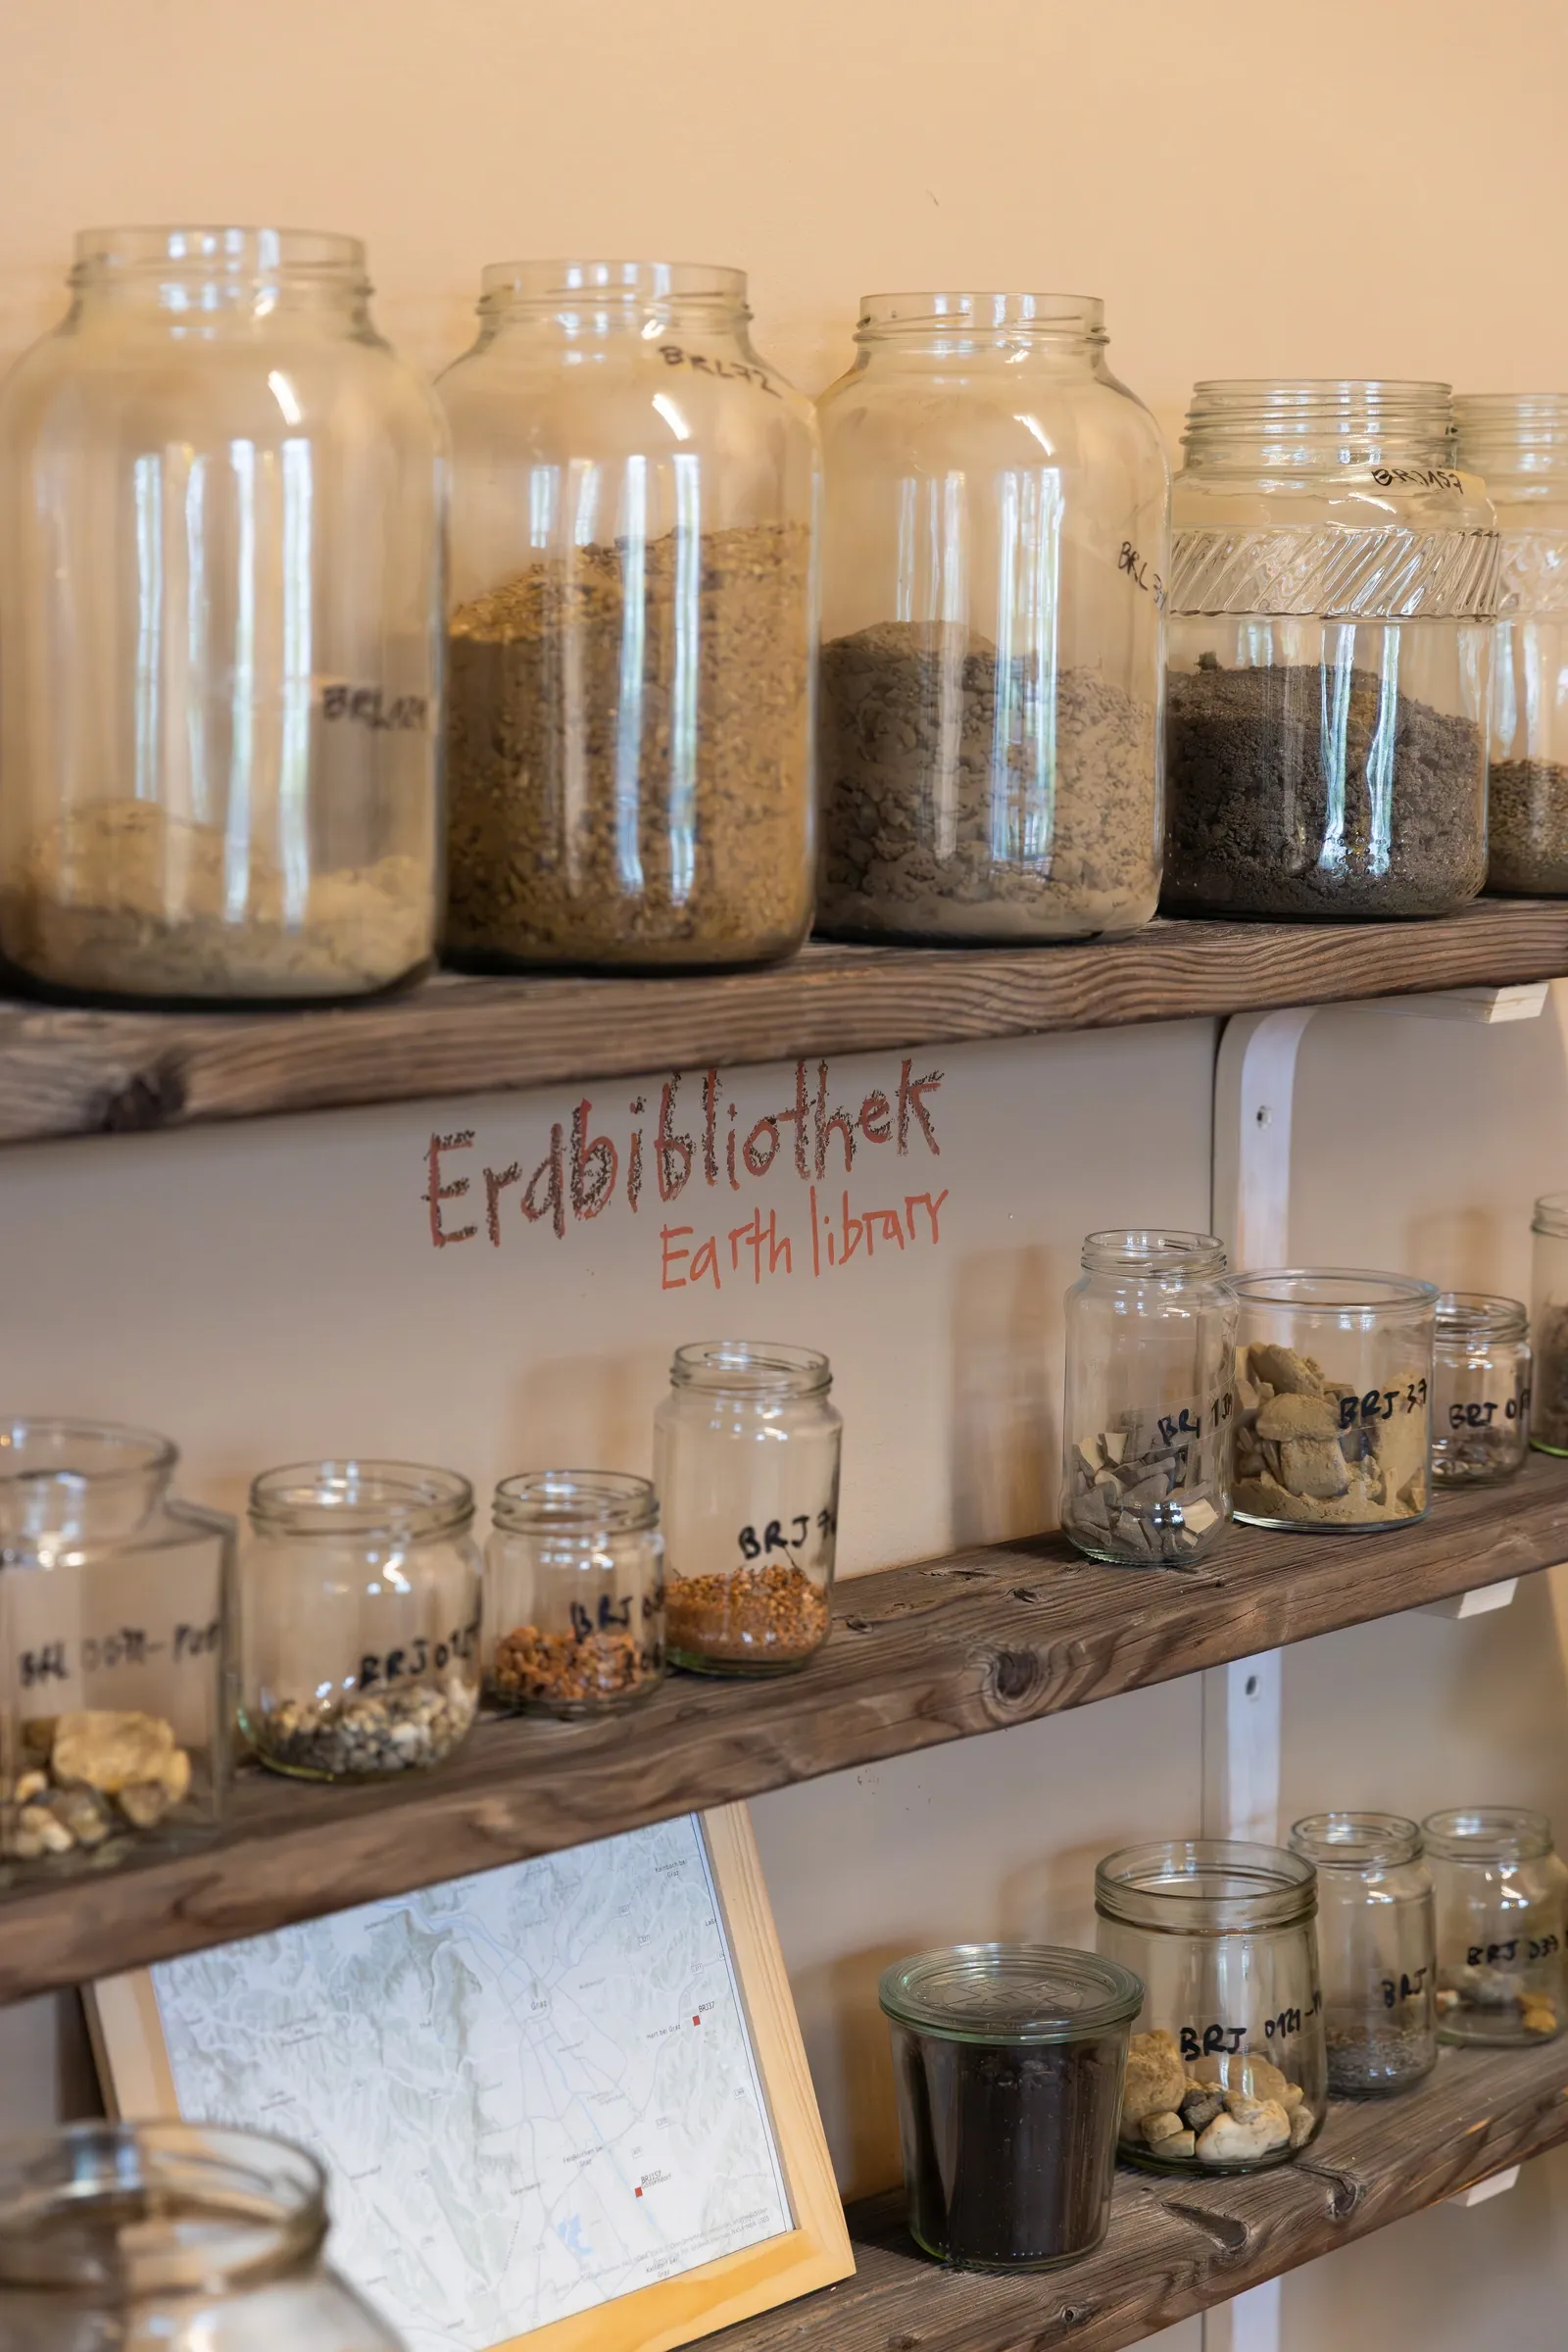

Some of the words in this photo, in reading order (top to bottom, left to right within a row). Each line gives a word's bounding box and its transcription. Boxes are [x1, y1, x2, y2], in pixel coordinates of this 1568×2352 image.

[421, 1057, 945, 1249] Erdbibliothek
[660, 1207, 792, 1291] Earth
[809, 1185, 950, 1277] library
[1338, 1390, 1400, 1430] BRJ
[1448, 1401, 1498, 1430] BRJ
[738, 1518, 810, 1560] BRJ
[666, 1869, 679, 1879] Graz
[1467, 1939, 1519, 1967] BRJ
[530, 2000, 548, 2011] Graz
[698, 2000, 715, 2013] BRJ37
[669, 2023, 681, 2034] Graz
[1180, 2024, 1247, 2062] BRJ
[640, 2169, 662, 2184] BRJ157
